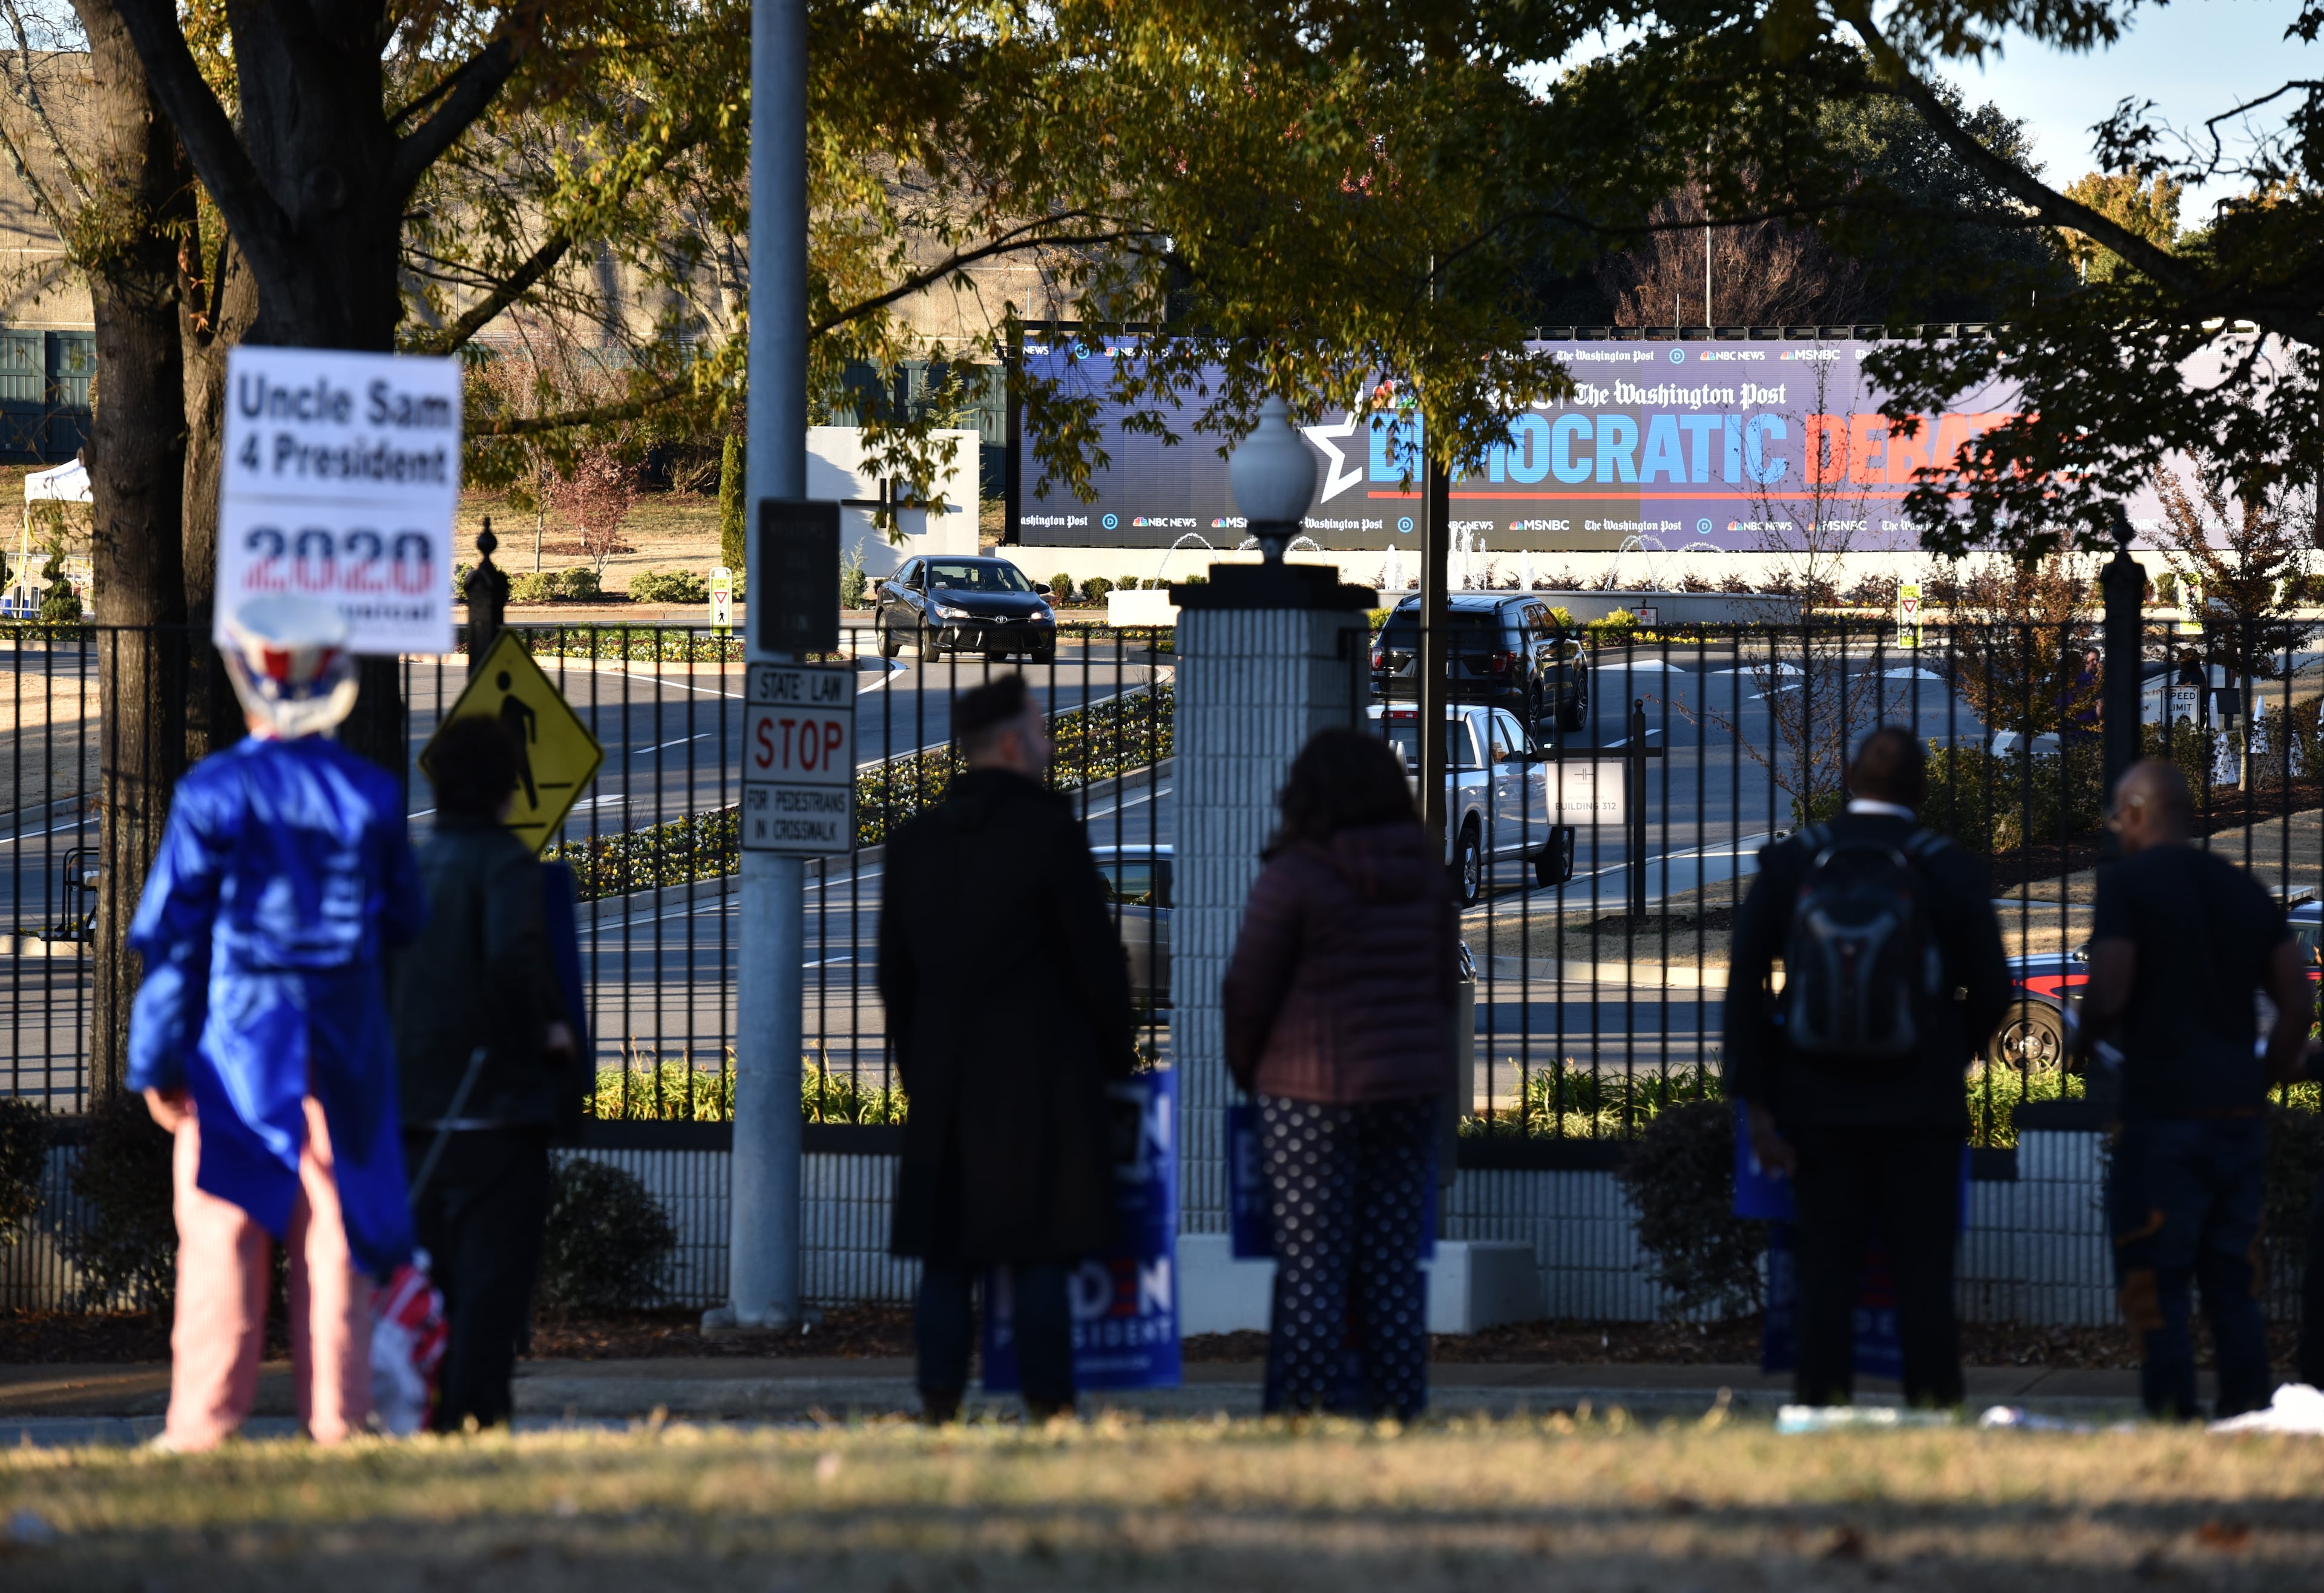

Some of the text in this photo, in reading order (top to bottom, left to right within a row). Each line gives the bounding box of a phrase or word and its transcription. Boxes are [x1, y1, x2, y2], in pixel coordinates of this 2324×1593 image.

[1023, 346, 1049, 355] NEWS
[1556, 349, 1574, 361] The
[1575, 349, 1632, 363] Washington
[1633, 350, 1655, 361] Post
[1715, 350, 1765, 361] NBC NEWS
[1795, 349, 1840, 360] MSNBC
[239, 373, 452, 428] Uncle Sam
[1574, 383, 1609, 409] The
[1613, 378, 1736, 410] Washington
[1739, 383, 1787, 411] Post
[238, 432, 446, 486] 4 President
[1067, 515, 1088, 528] Post
[1149, 517, 1197, 528] NBC NEWS
[1305, 516, 1384, 531] Washington Post
[1466, 521, 1494, 530] NEWS
[1523, 519, 1571, 531] MSNBC
[1584, 519, 1682, 533] The Washington Post
[1743, 521, 1793, 531] NBC NEWS
[1882, 521, 1899, 533] The
[243, 527, 434, 594] 2020
[760, 672, 842, 701] STATE LAW
[755, 717, 844, 772] STOP
[747, 789, 845, 815] FOR PEDESTRIANS
[755, 818, 837, 842] IN CROSSWALK
